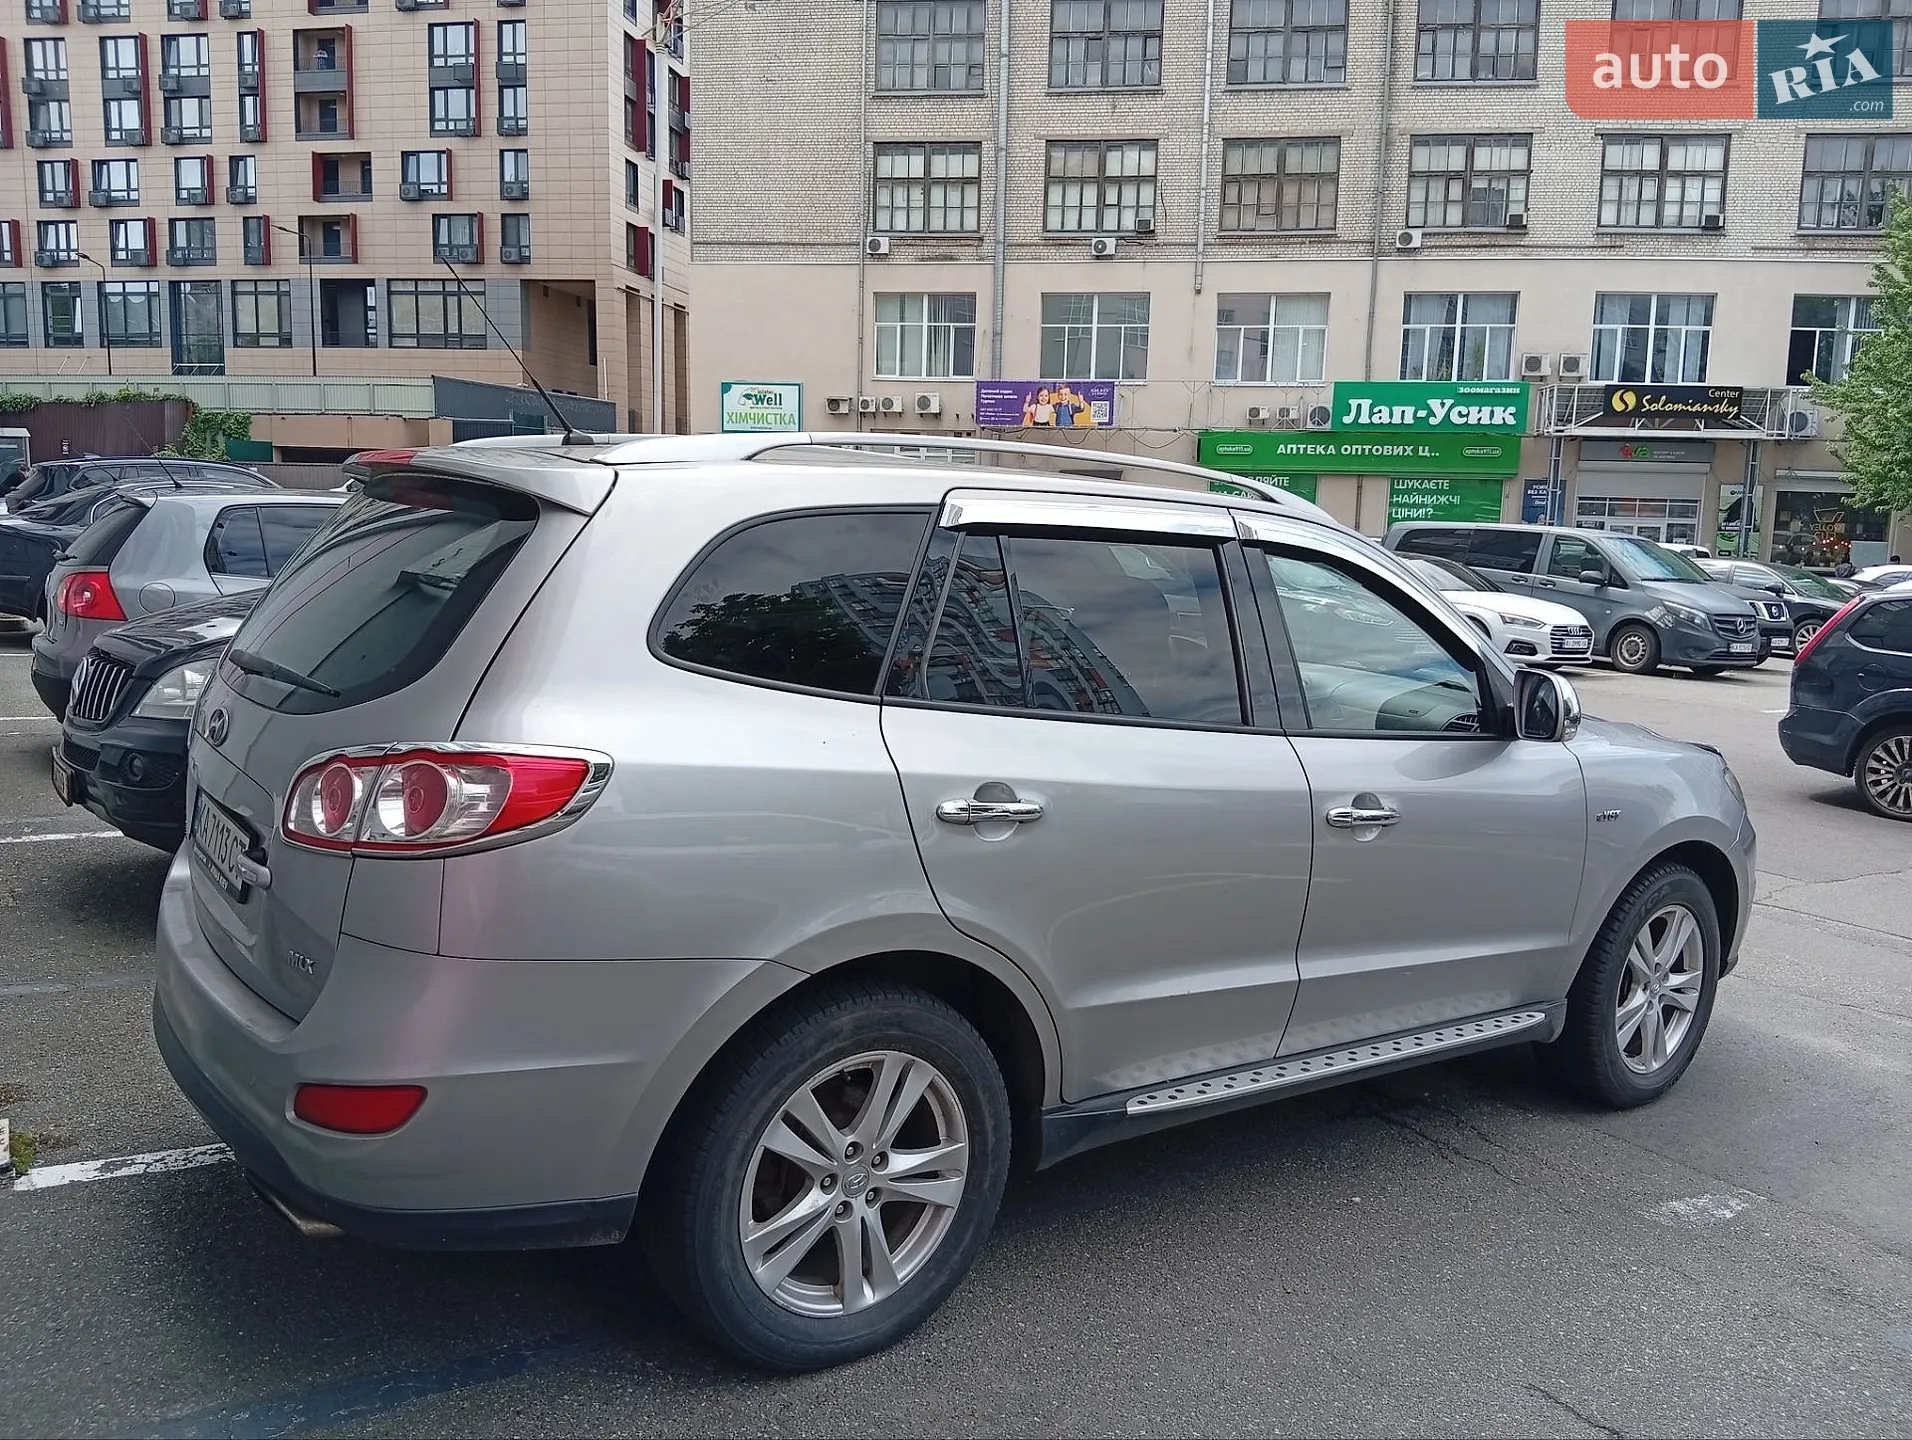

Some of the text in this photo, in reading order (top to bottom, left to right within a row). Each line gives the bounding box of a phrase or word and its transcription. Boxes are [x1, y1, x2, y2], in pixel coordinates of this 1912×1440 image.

[1457, 386, 1521, 394] зоомагазин
[1708, 388, 1740, 399] Center
[754, 393, 783, 406] Well
[1342, 399, 1517, 425] Лап-Усик
[1641, 395, 1740, 418] Solomiansky
[726, 411, 796, 425] ХІМЧИСТКА
[1276, 444, 1336, 455] АПТЕКА
[1341, 445, 1413, 456] ОПТОВИХ
[1394, 479, 1450, 489] ШУКАЄТЕ
[1393, 492, 1460, 505] НАЙНИЖЧІ
[208, 813, 230, 864] 7113
